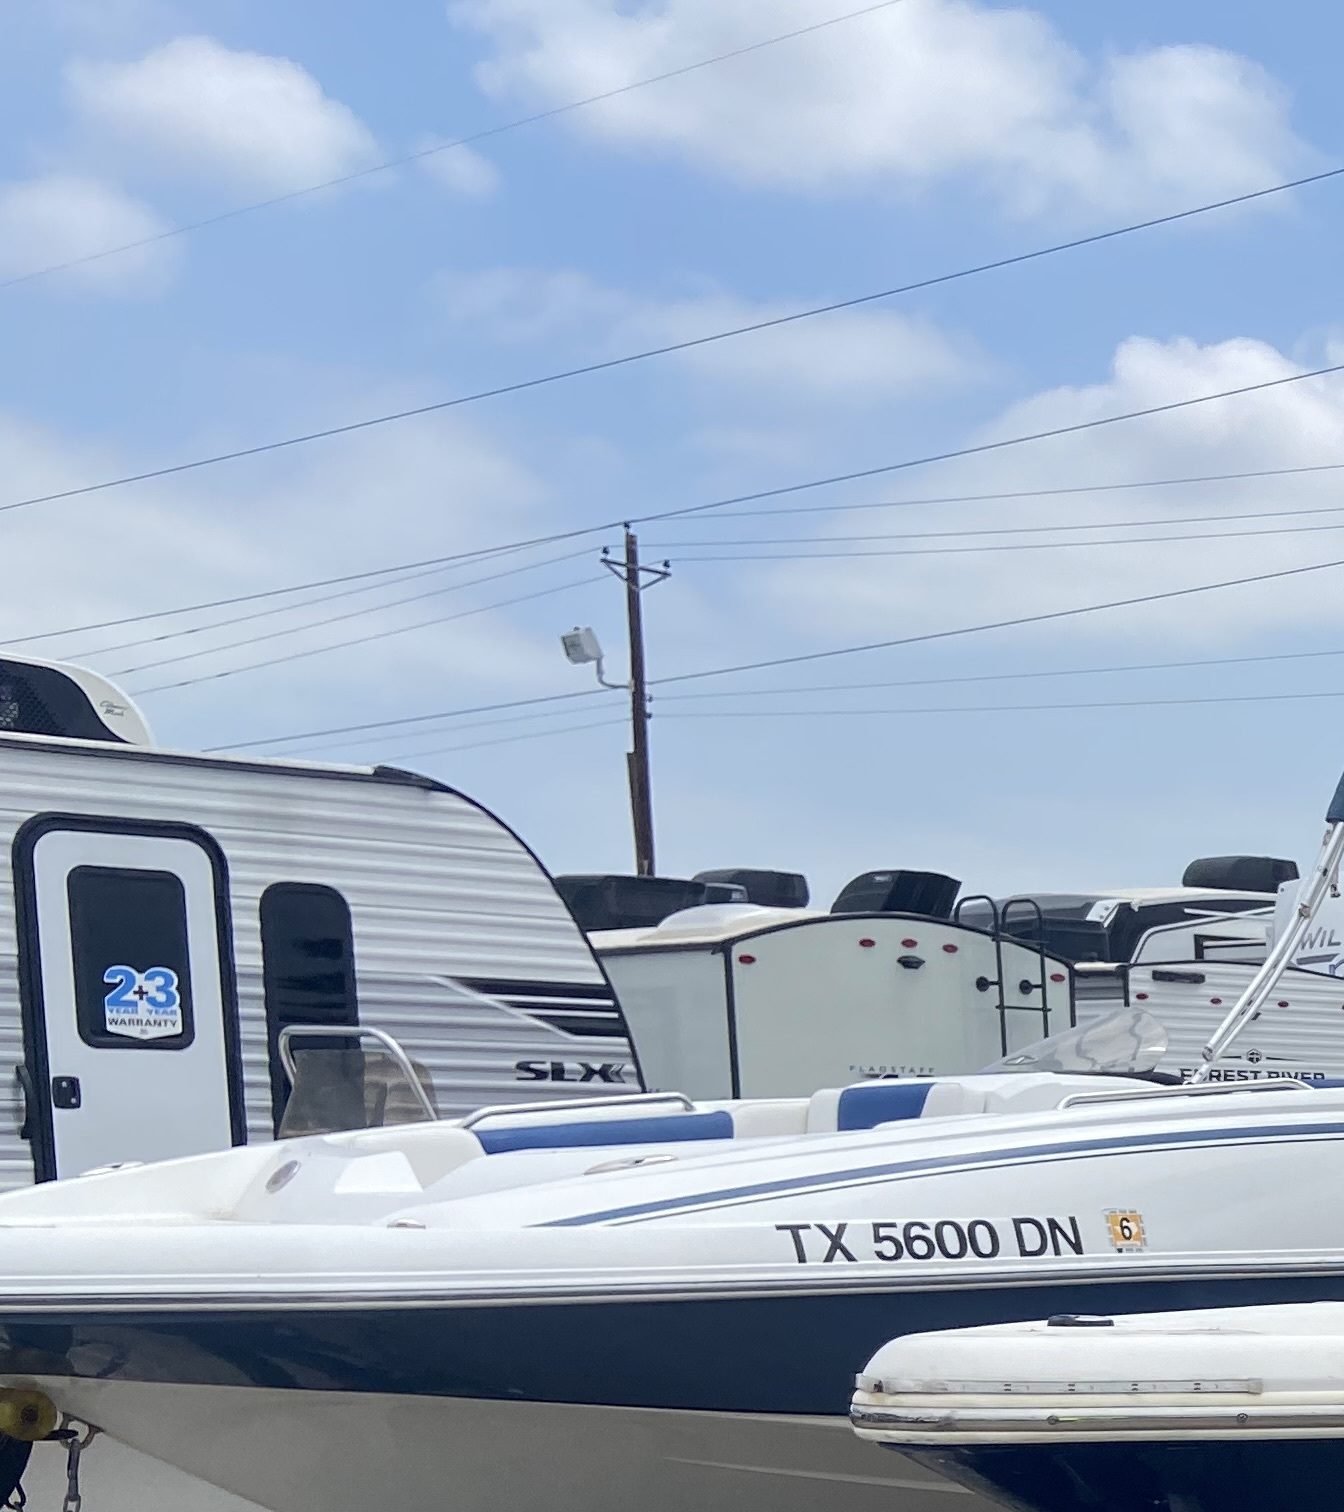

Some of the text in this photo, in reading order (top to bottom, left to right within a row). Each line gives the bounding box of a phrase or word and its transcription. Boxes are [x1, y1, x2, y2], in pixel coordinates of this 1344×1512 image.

[108, 1018, 177, 1028] WARRANTY
[515, 1060, 616, 1083] SLX
[849, 1065, 935, 1074] FLAGSTAFF
[775, 1216, 1084, 1264] TX 5600 DN
[1119, 1216, 1133, 1241] 6
